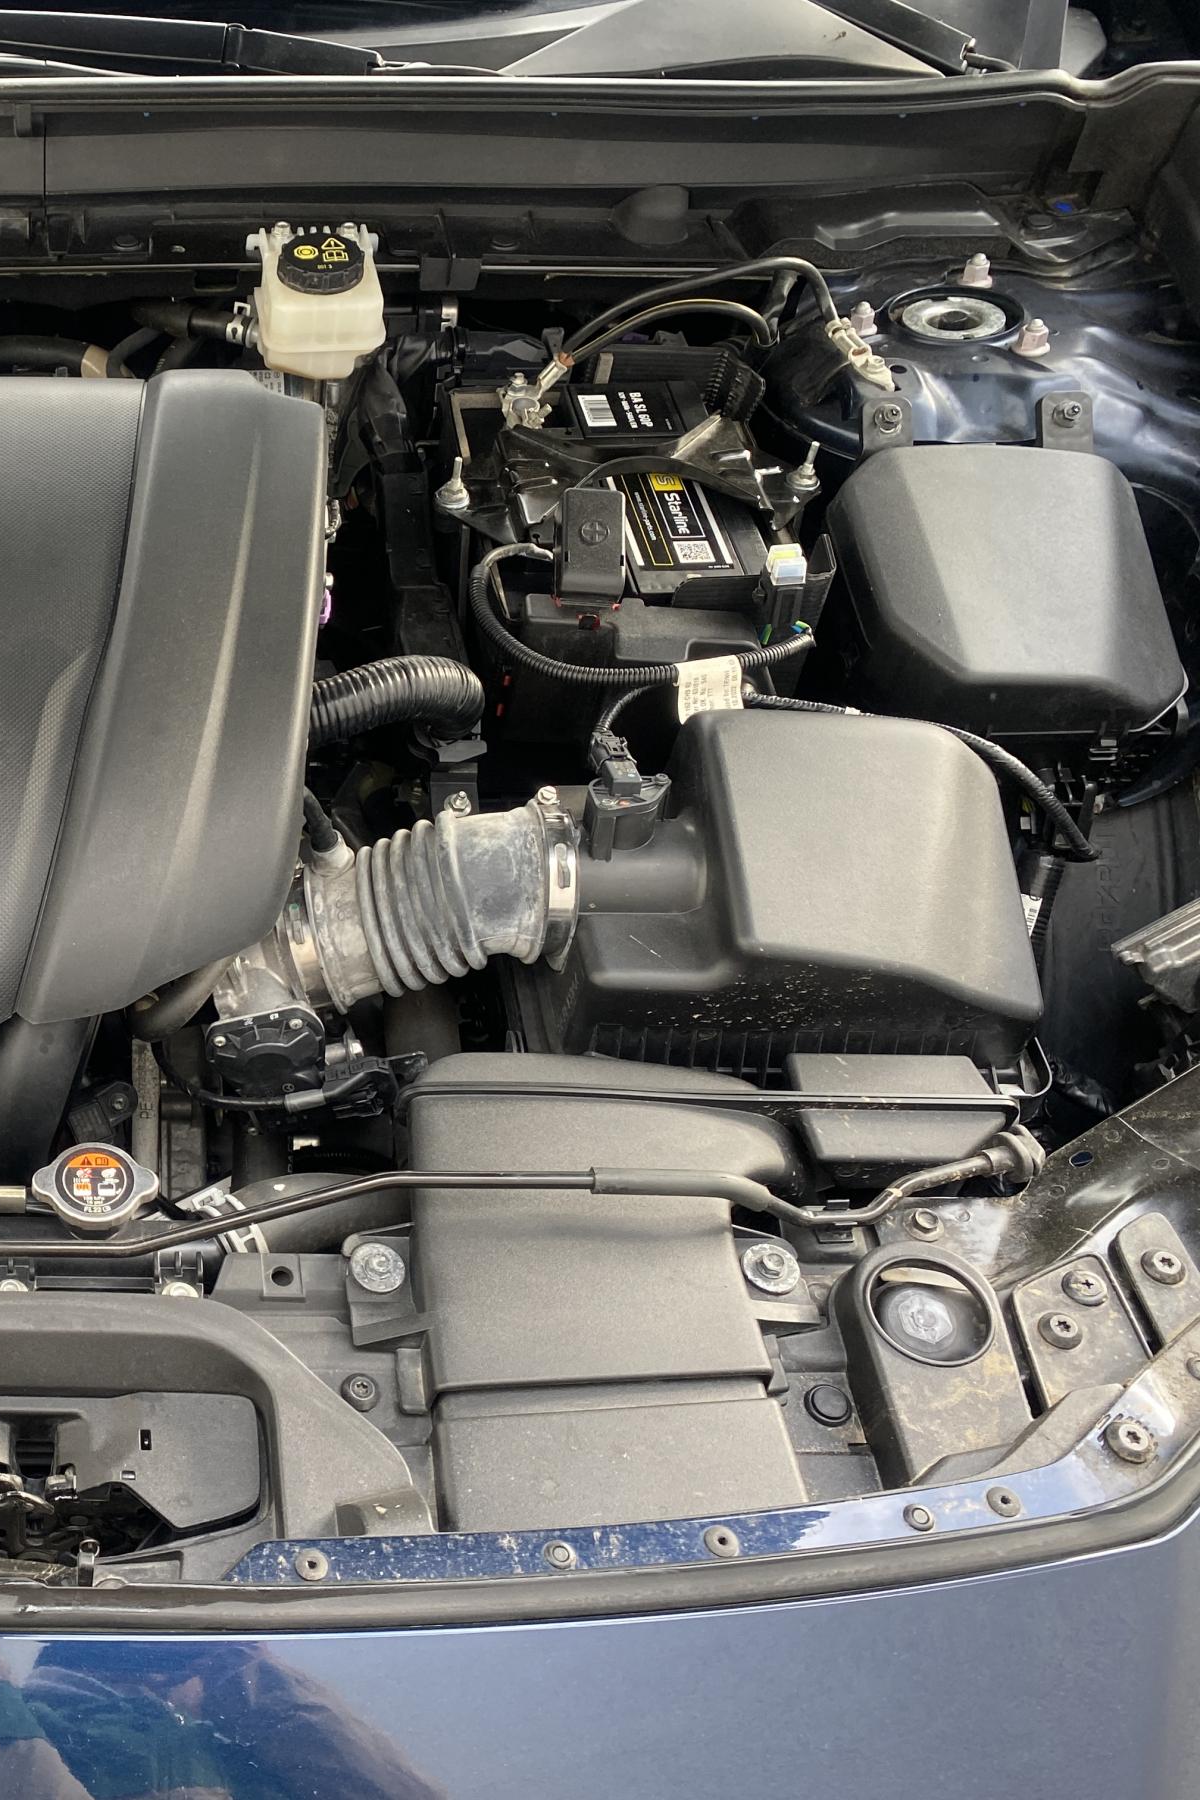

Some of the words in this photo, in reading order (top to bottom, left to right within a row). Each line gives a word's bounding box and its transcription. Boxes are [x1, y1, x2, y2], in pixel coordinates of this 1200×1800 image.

[629, 392, 643, 403] BA
[634, 403, 648, 414] SL
[638, 413, 654, 427] 60P
[663, 492, 691, 535] Starline
[84, 1205, 102, 1213] FL22
